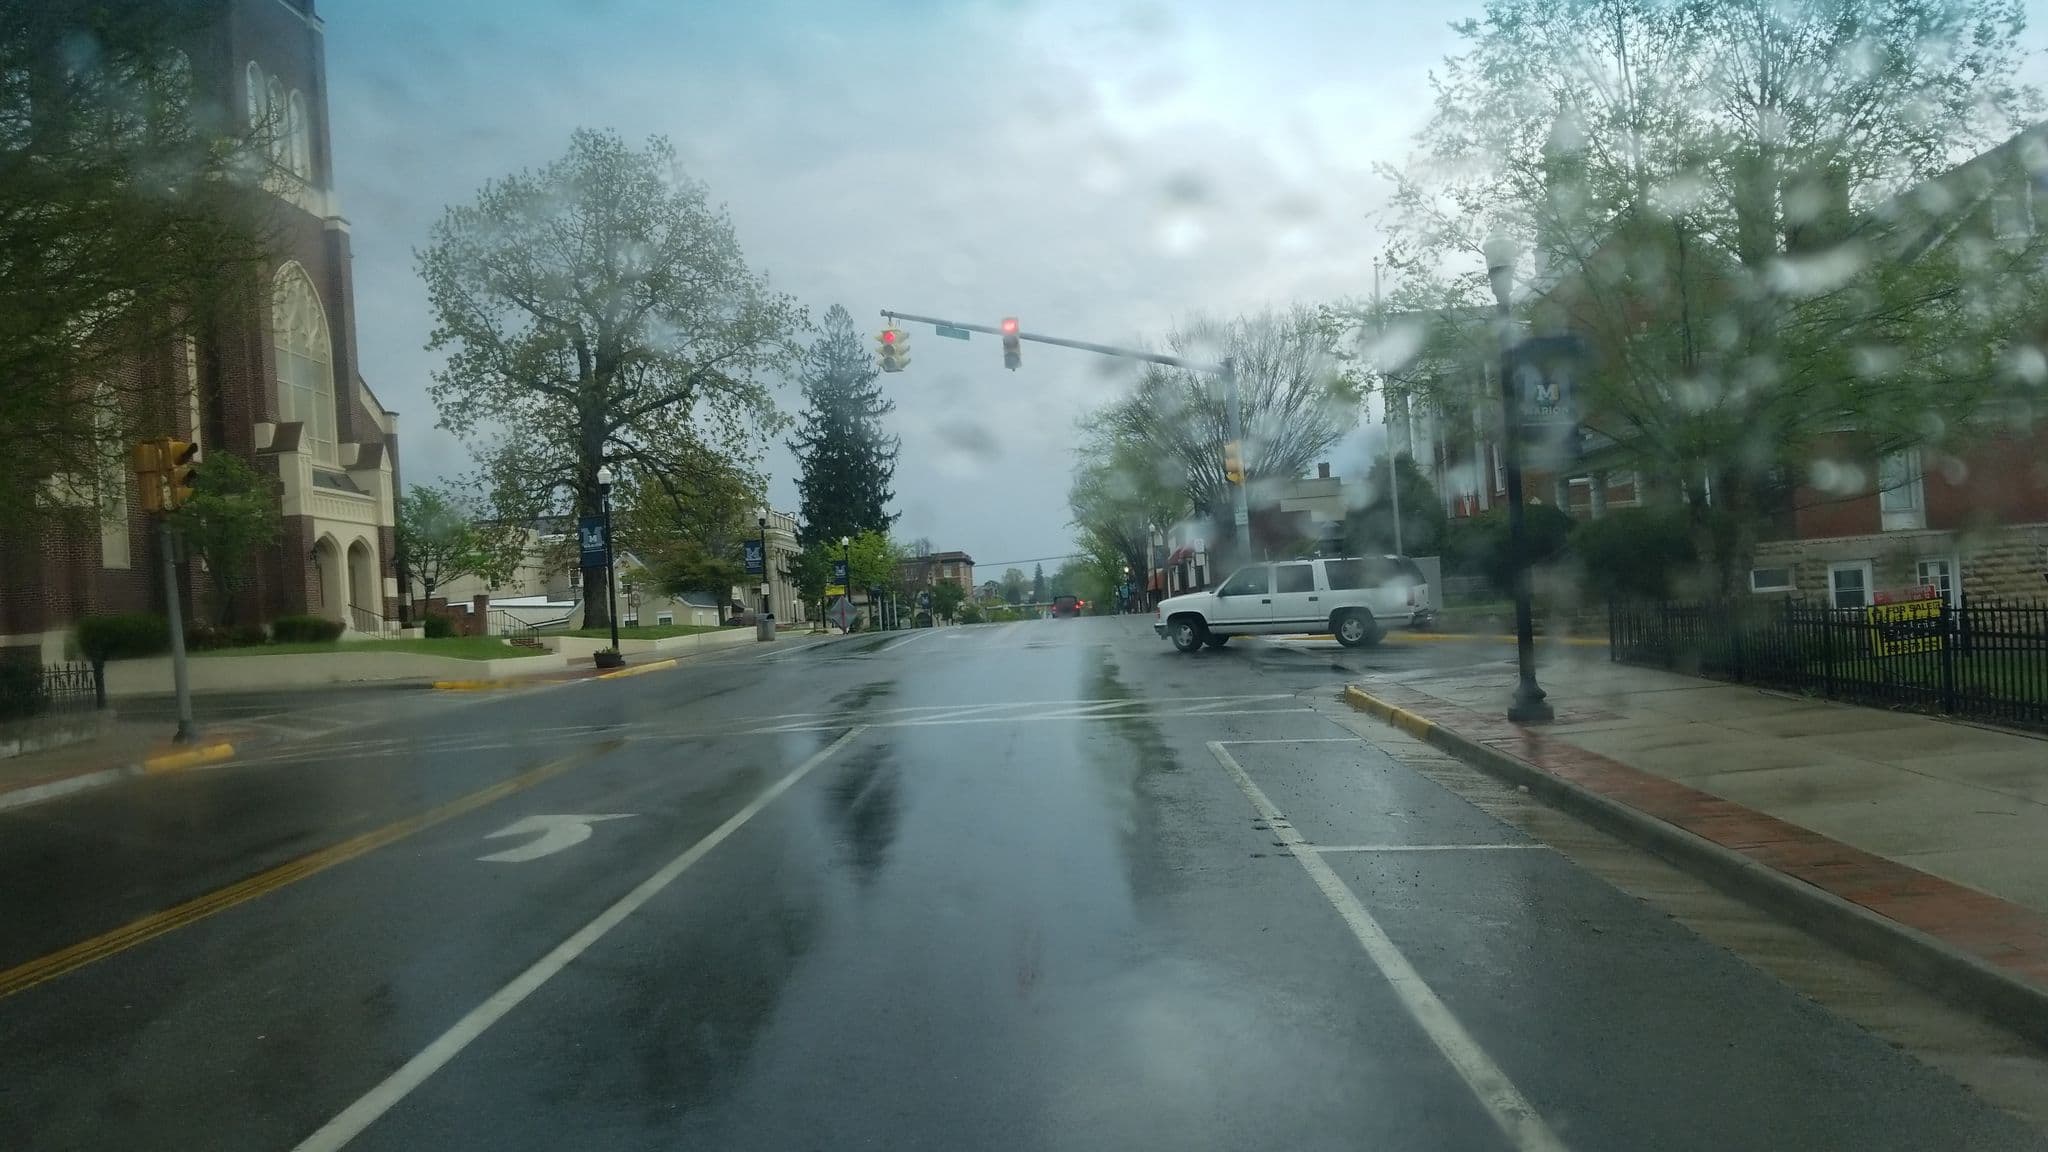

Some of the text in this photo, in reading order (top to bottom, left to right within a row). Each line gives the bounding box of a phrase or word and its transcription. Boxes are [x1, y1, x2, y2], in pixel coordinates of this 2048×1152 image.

[1536, 384, 1559, 400] M
[1887, 602, 1932, 614] FOR SALE
